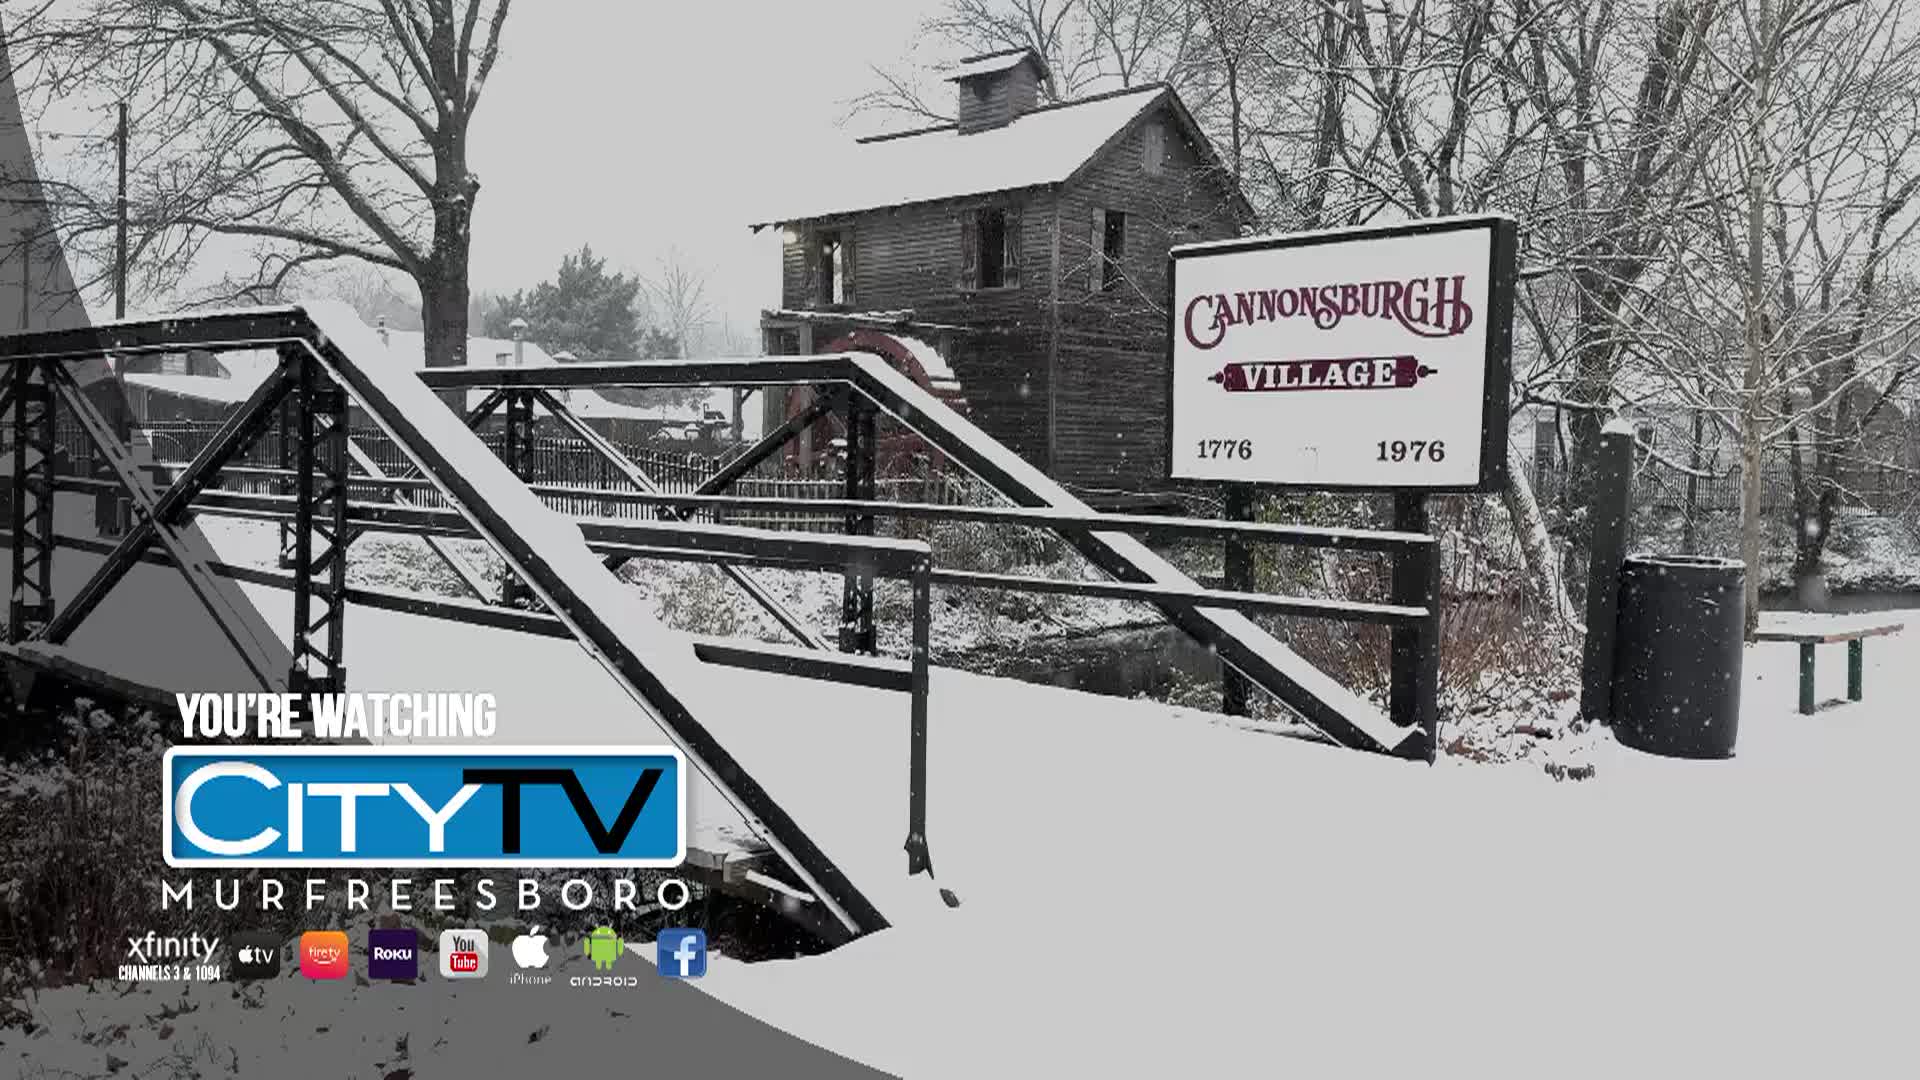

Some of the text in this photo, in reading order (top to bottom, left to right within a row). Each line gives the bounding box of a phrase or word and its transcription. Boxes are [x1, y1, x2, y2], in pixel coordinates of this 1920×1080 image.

[1184, 275, 1473, 350] CANNONSBURGH
[1241, 359, 1397, 391] VILLAGE
[1197, 439, 1446, 462] 1776 1976
